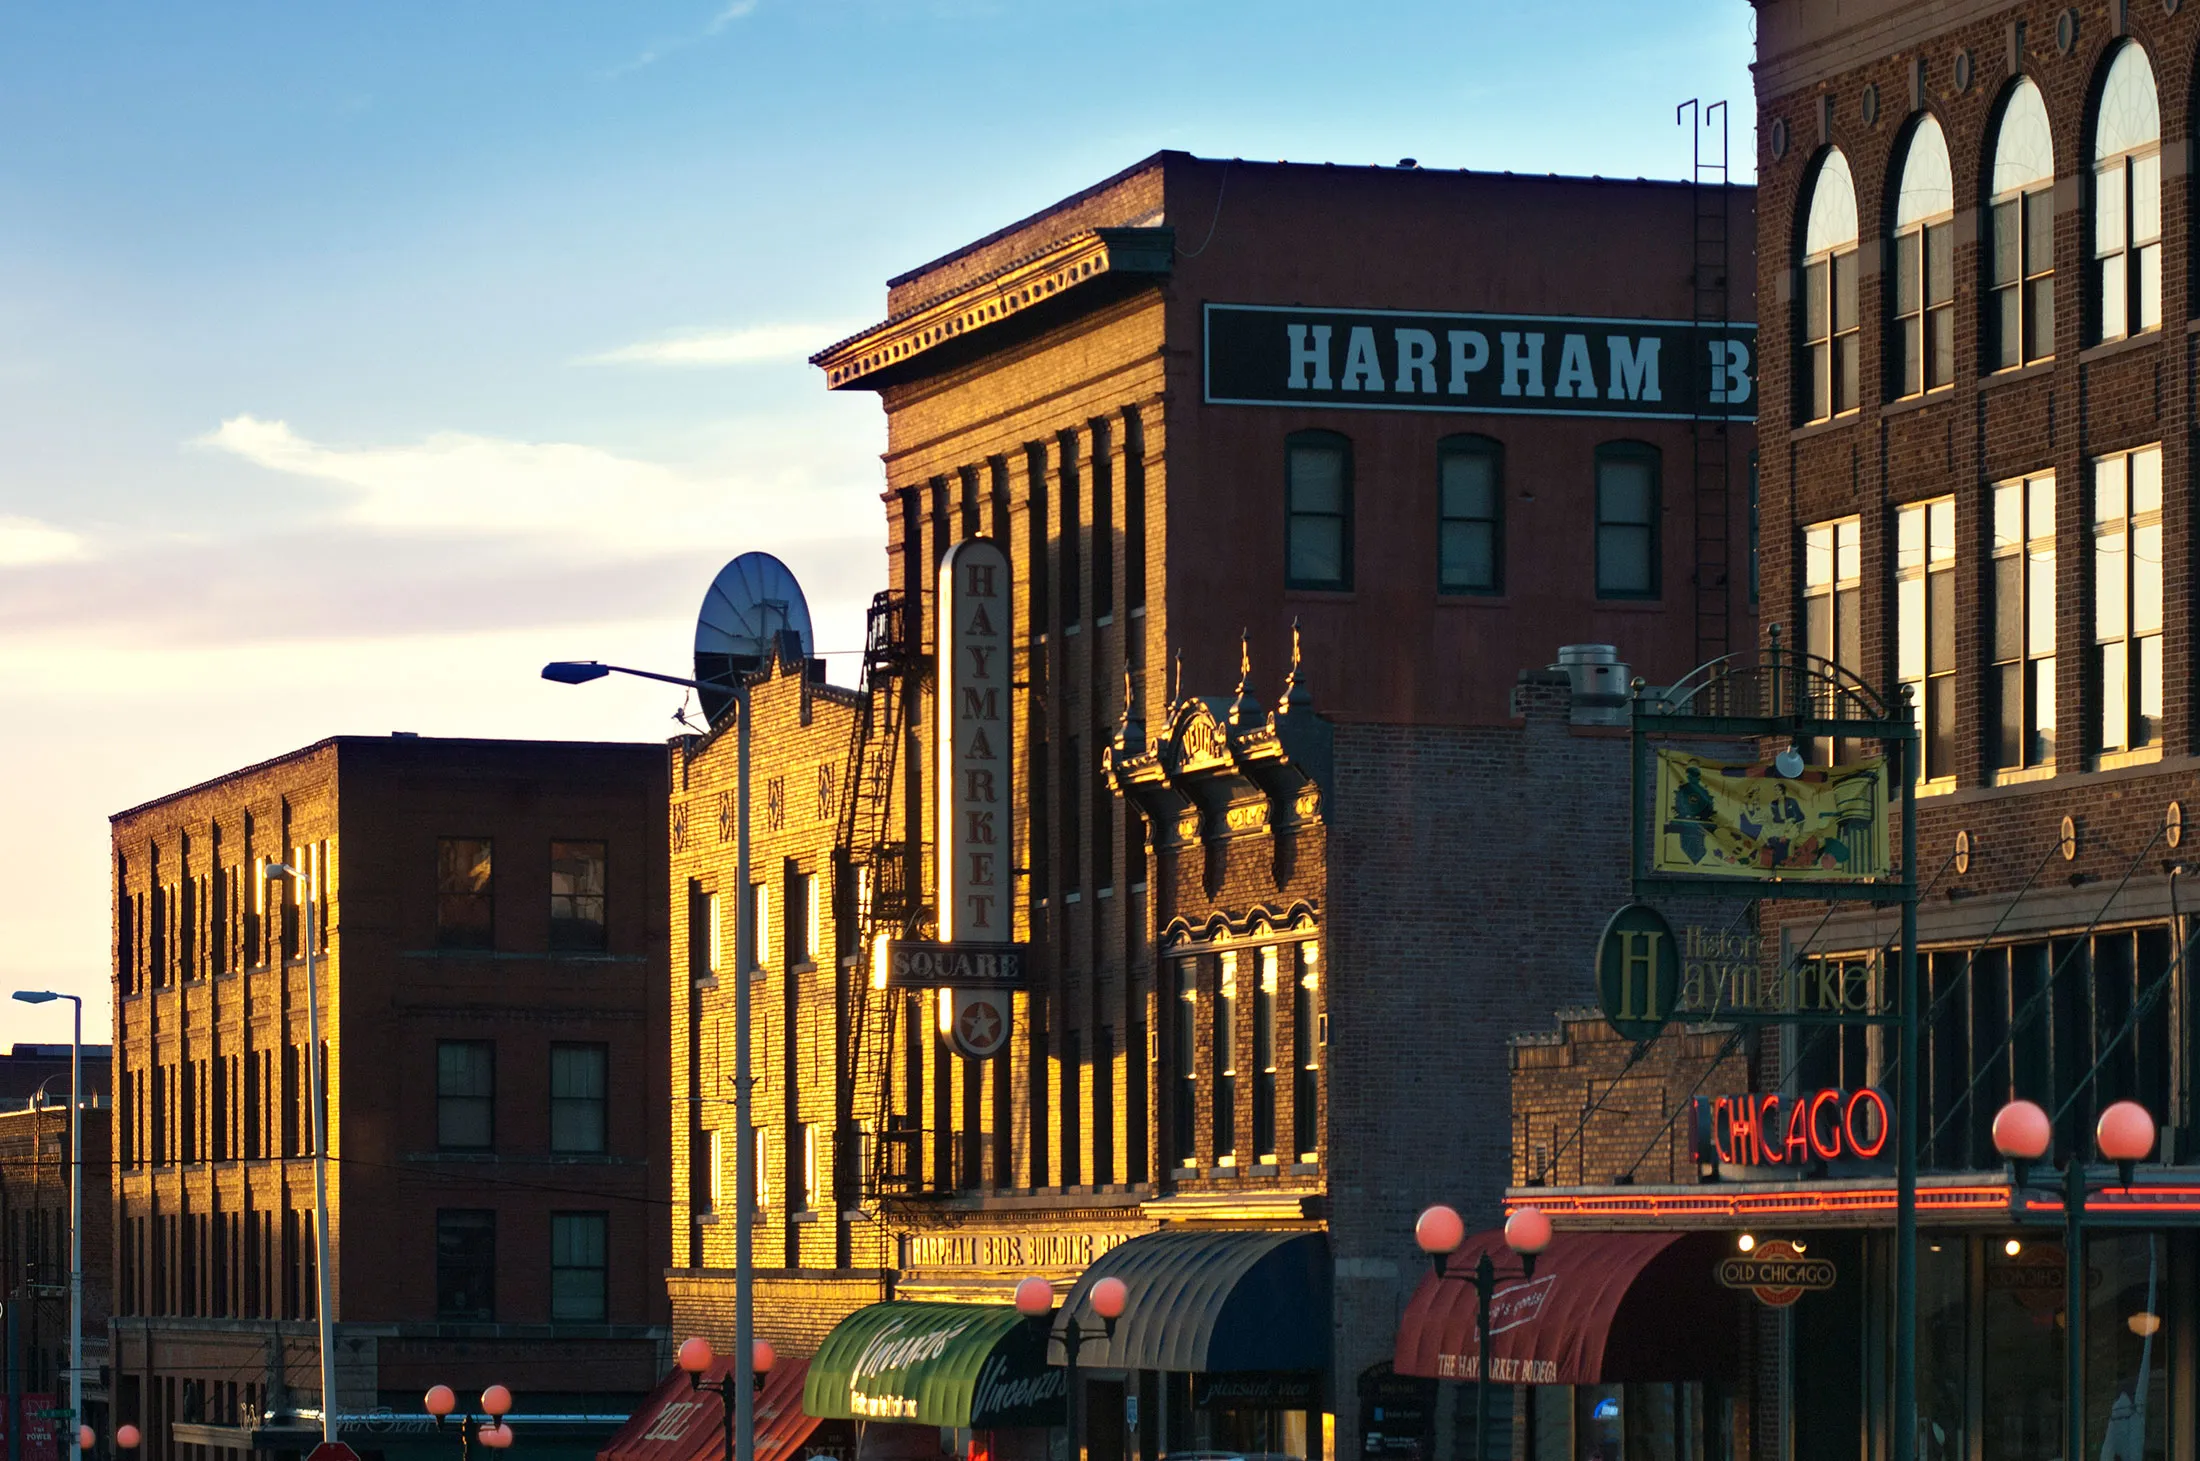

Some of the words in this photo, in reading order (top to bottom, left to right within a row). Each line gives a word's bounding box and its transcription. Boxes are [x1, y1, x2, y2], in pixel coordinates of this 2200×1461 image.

[1287, 324, 1662, 401] HARPHAM
[961, 564, 1000, 929] HAYMARKET
[892, 951, 1019, 979] SQUARE
[1714, 1087, 1889, 1166] CHICAGO
[911, 1237, 976, 1265] HARPHAM
[982, 1236, 1025, 1265] BROS.
[1027, 1234, 1093, 1265] BUILDING
[1725, 1264, 1755, 1281] OLD
[1760, 1264, 1832, 1284] CHICAGO
[1438, 1354, 1457, 1377] THE
[1459, 1355, 1520, 1382] HAYARKET
[1521, 1359, 1557, 1383] BODEGA
